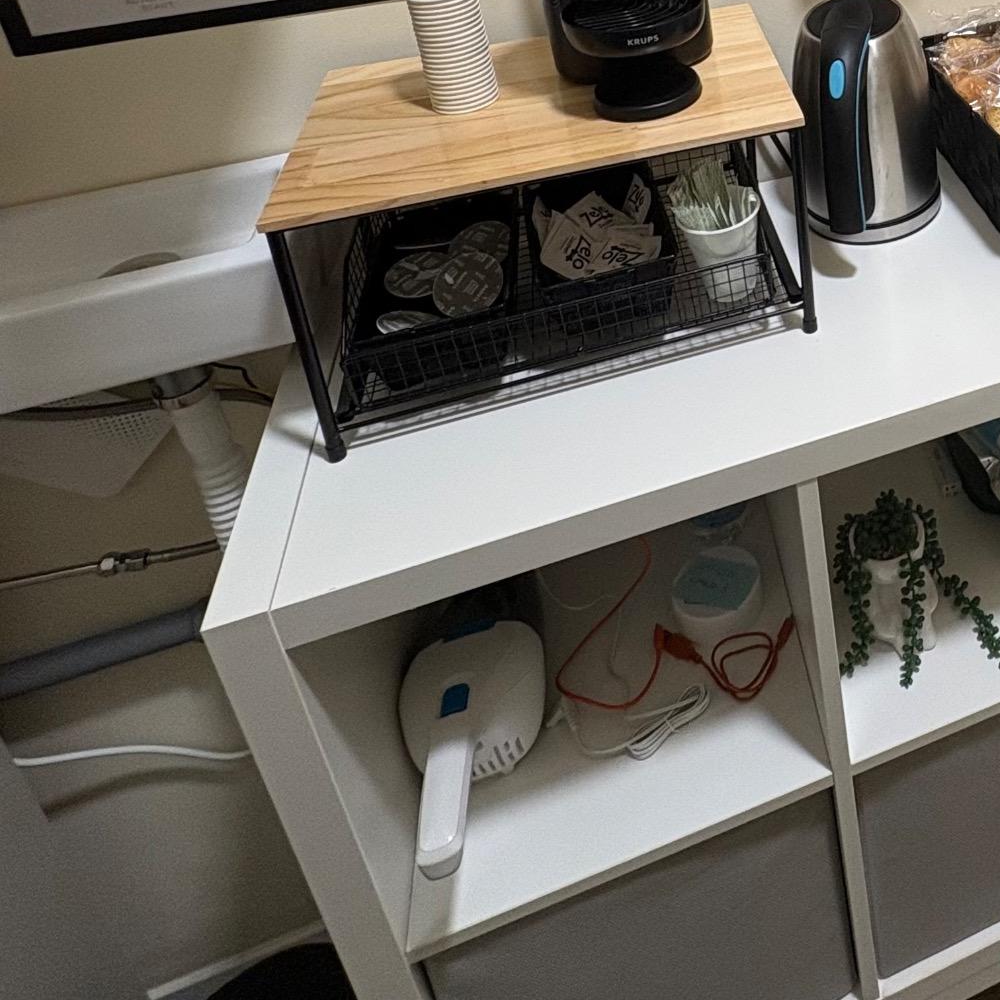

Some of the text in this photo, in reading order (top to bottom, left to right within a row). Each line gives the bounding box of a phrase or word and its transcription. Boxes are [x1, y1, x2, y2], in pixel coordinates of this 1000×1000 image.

[627, 34, 660, 46] KRUPS
[566, 235, 592, 270] Zelo
[602, 246, 645, 266] Zelo
